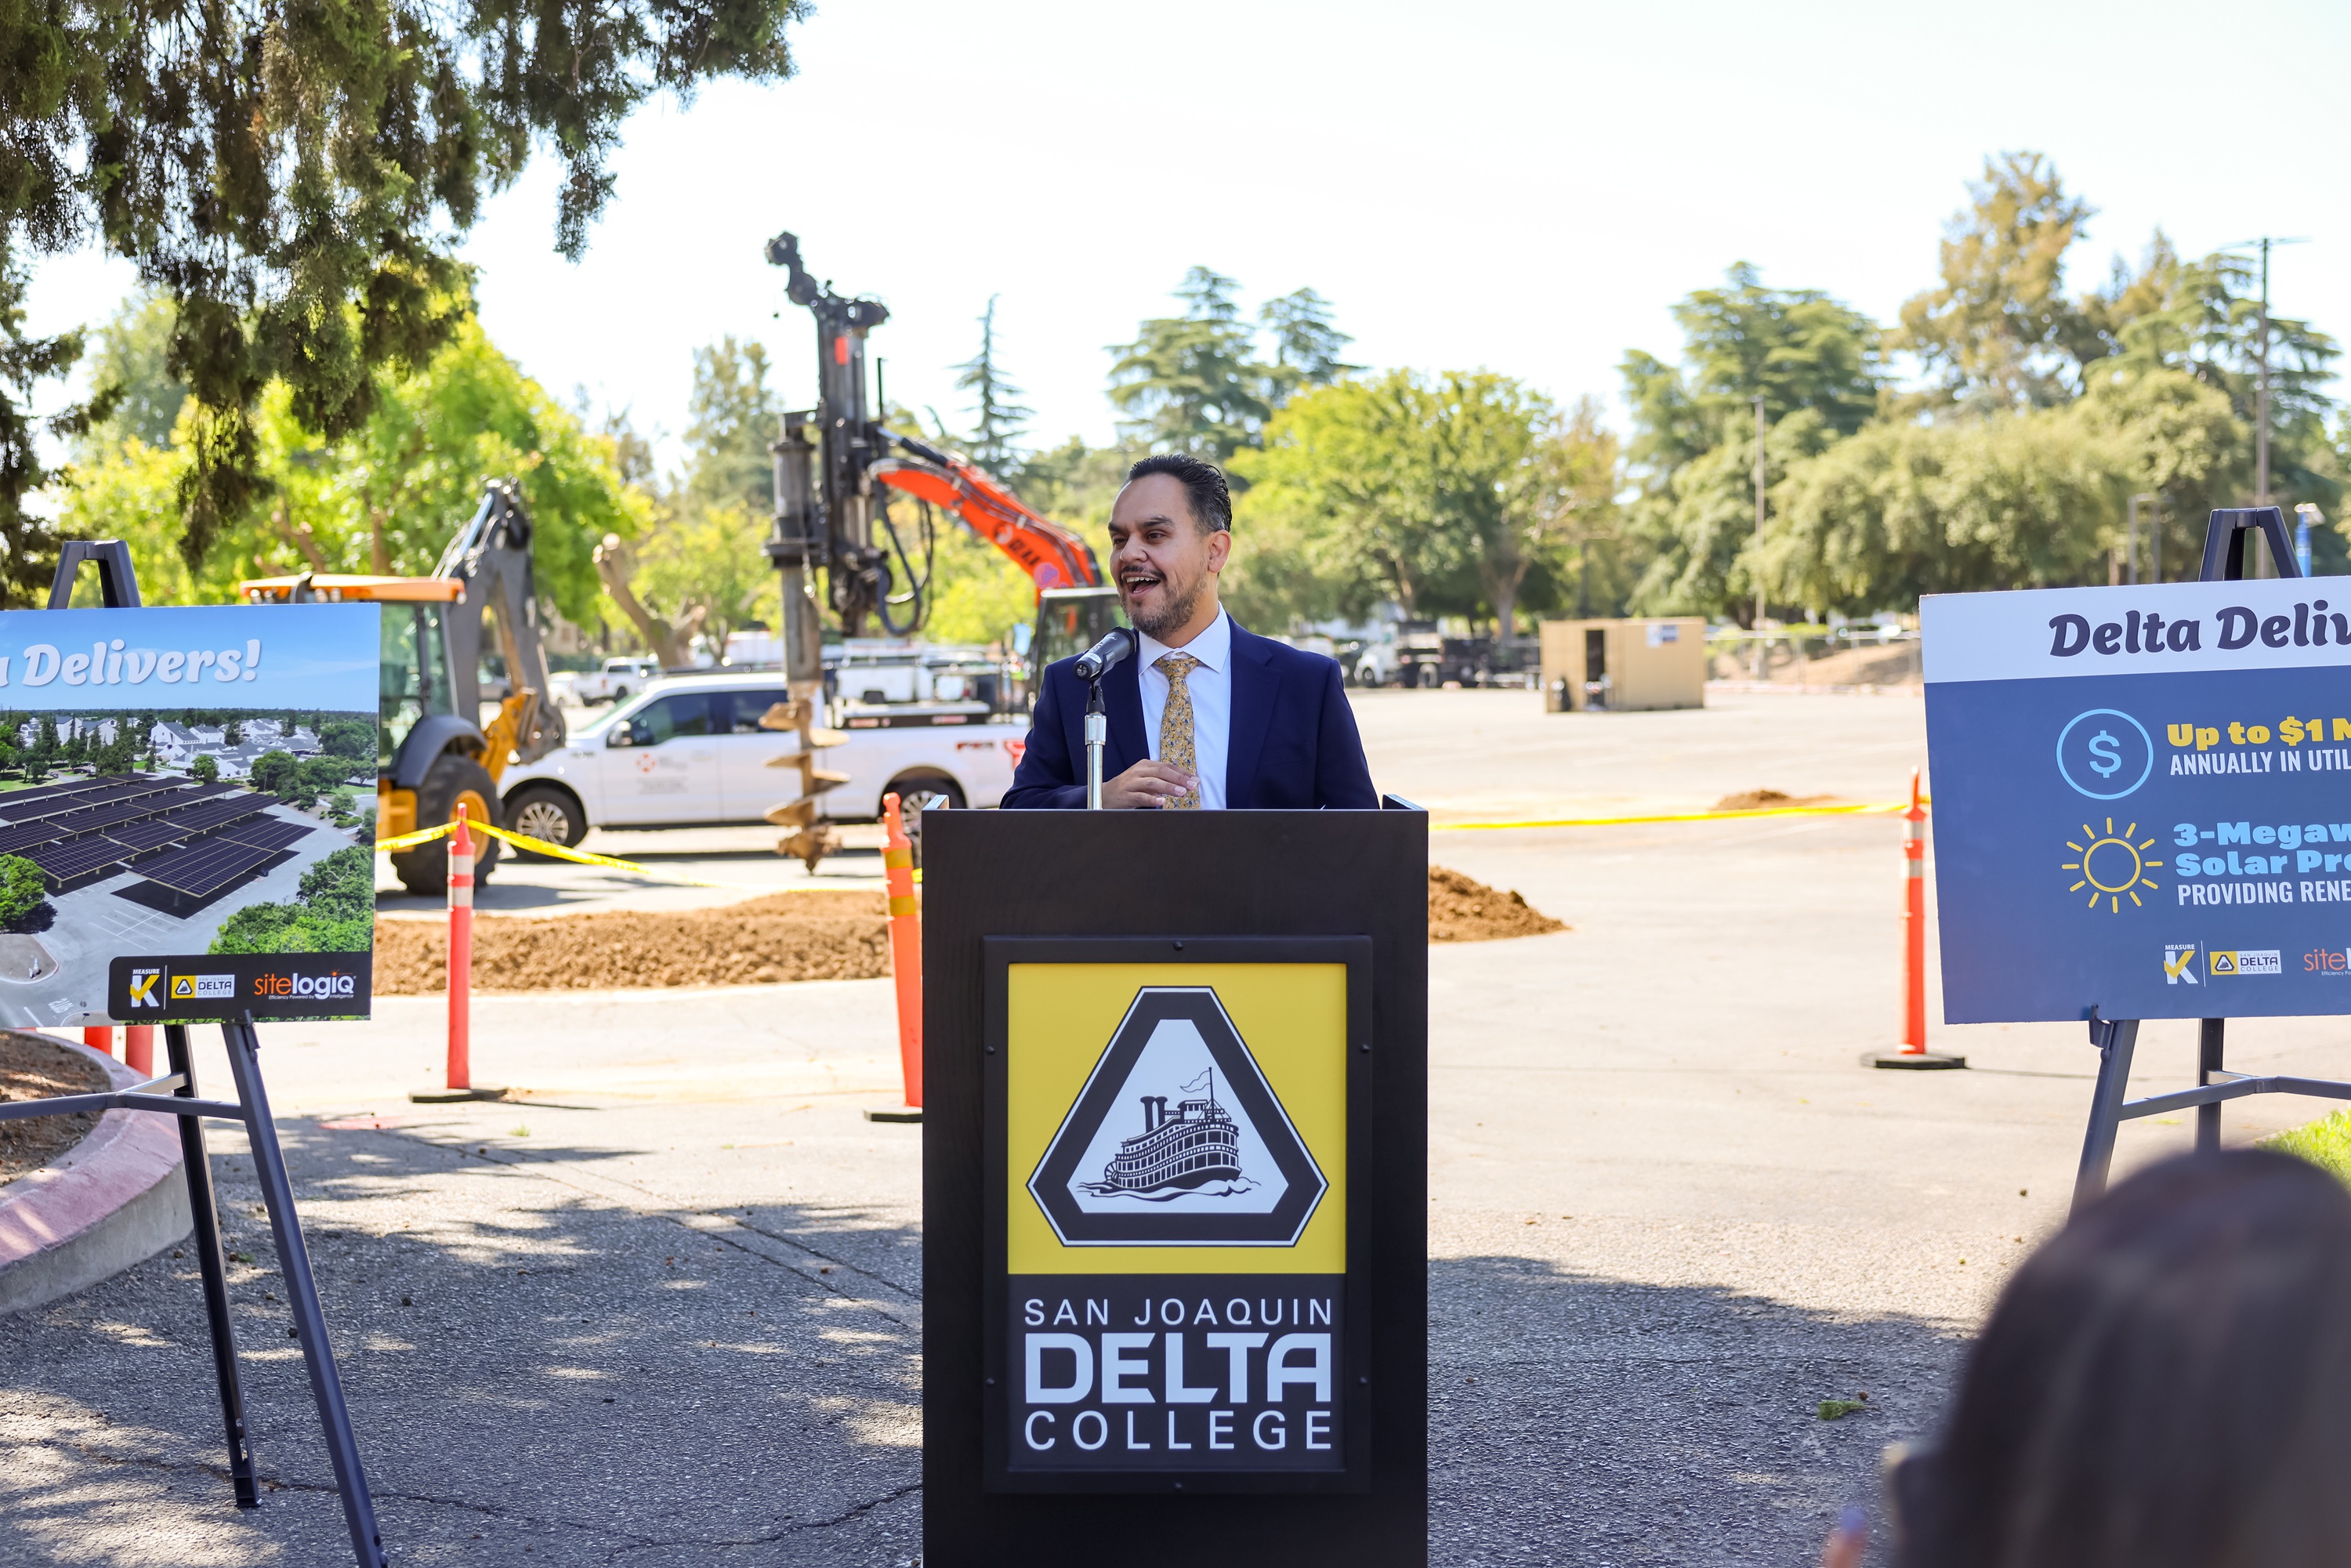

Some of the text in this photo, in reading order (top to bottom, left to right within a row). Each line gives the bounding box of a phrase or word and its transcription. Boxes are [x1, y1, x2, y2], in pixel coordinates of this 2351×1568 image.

[2049, 610, 2202, 657] Delta
[22, 639, 261, 686] Delivers!
[2167, 723, 2219, 751] Up
[2227, 722, 2270, 744] to
[2279, 716, 2324, 746] $1
[2170, 748, 2351, 776] ANNUALLY IN UTIL
[2175, 851, 2288, 877] Solar
[2178, 880, 2351, 906] PROVIDING RENE
[2164, 951, 2198, 984] K
[2240, 957, 2278, 966] DELTA
[130, 975, 160, 1008] K
[198, 981, 232, 990] DELTA
[1024, 1298, 1331, 1326] SAN JOAQUIN
[1025, 1332, 1331, 1403] DELTA
[1024, 1410, 1331, 1450] COLLEGE
